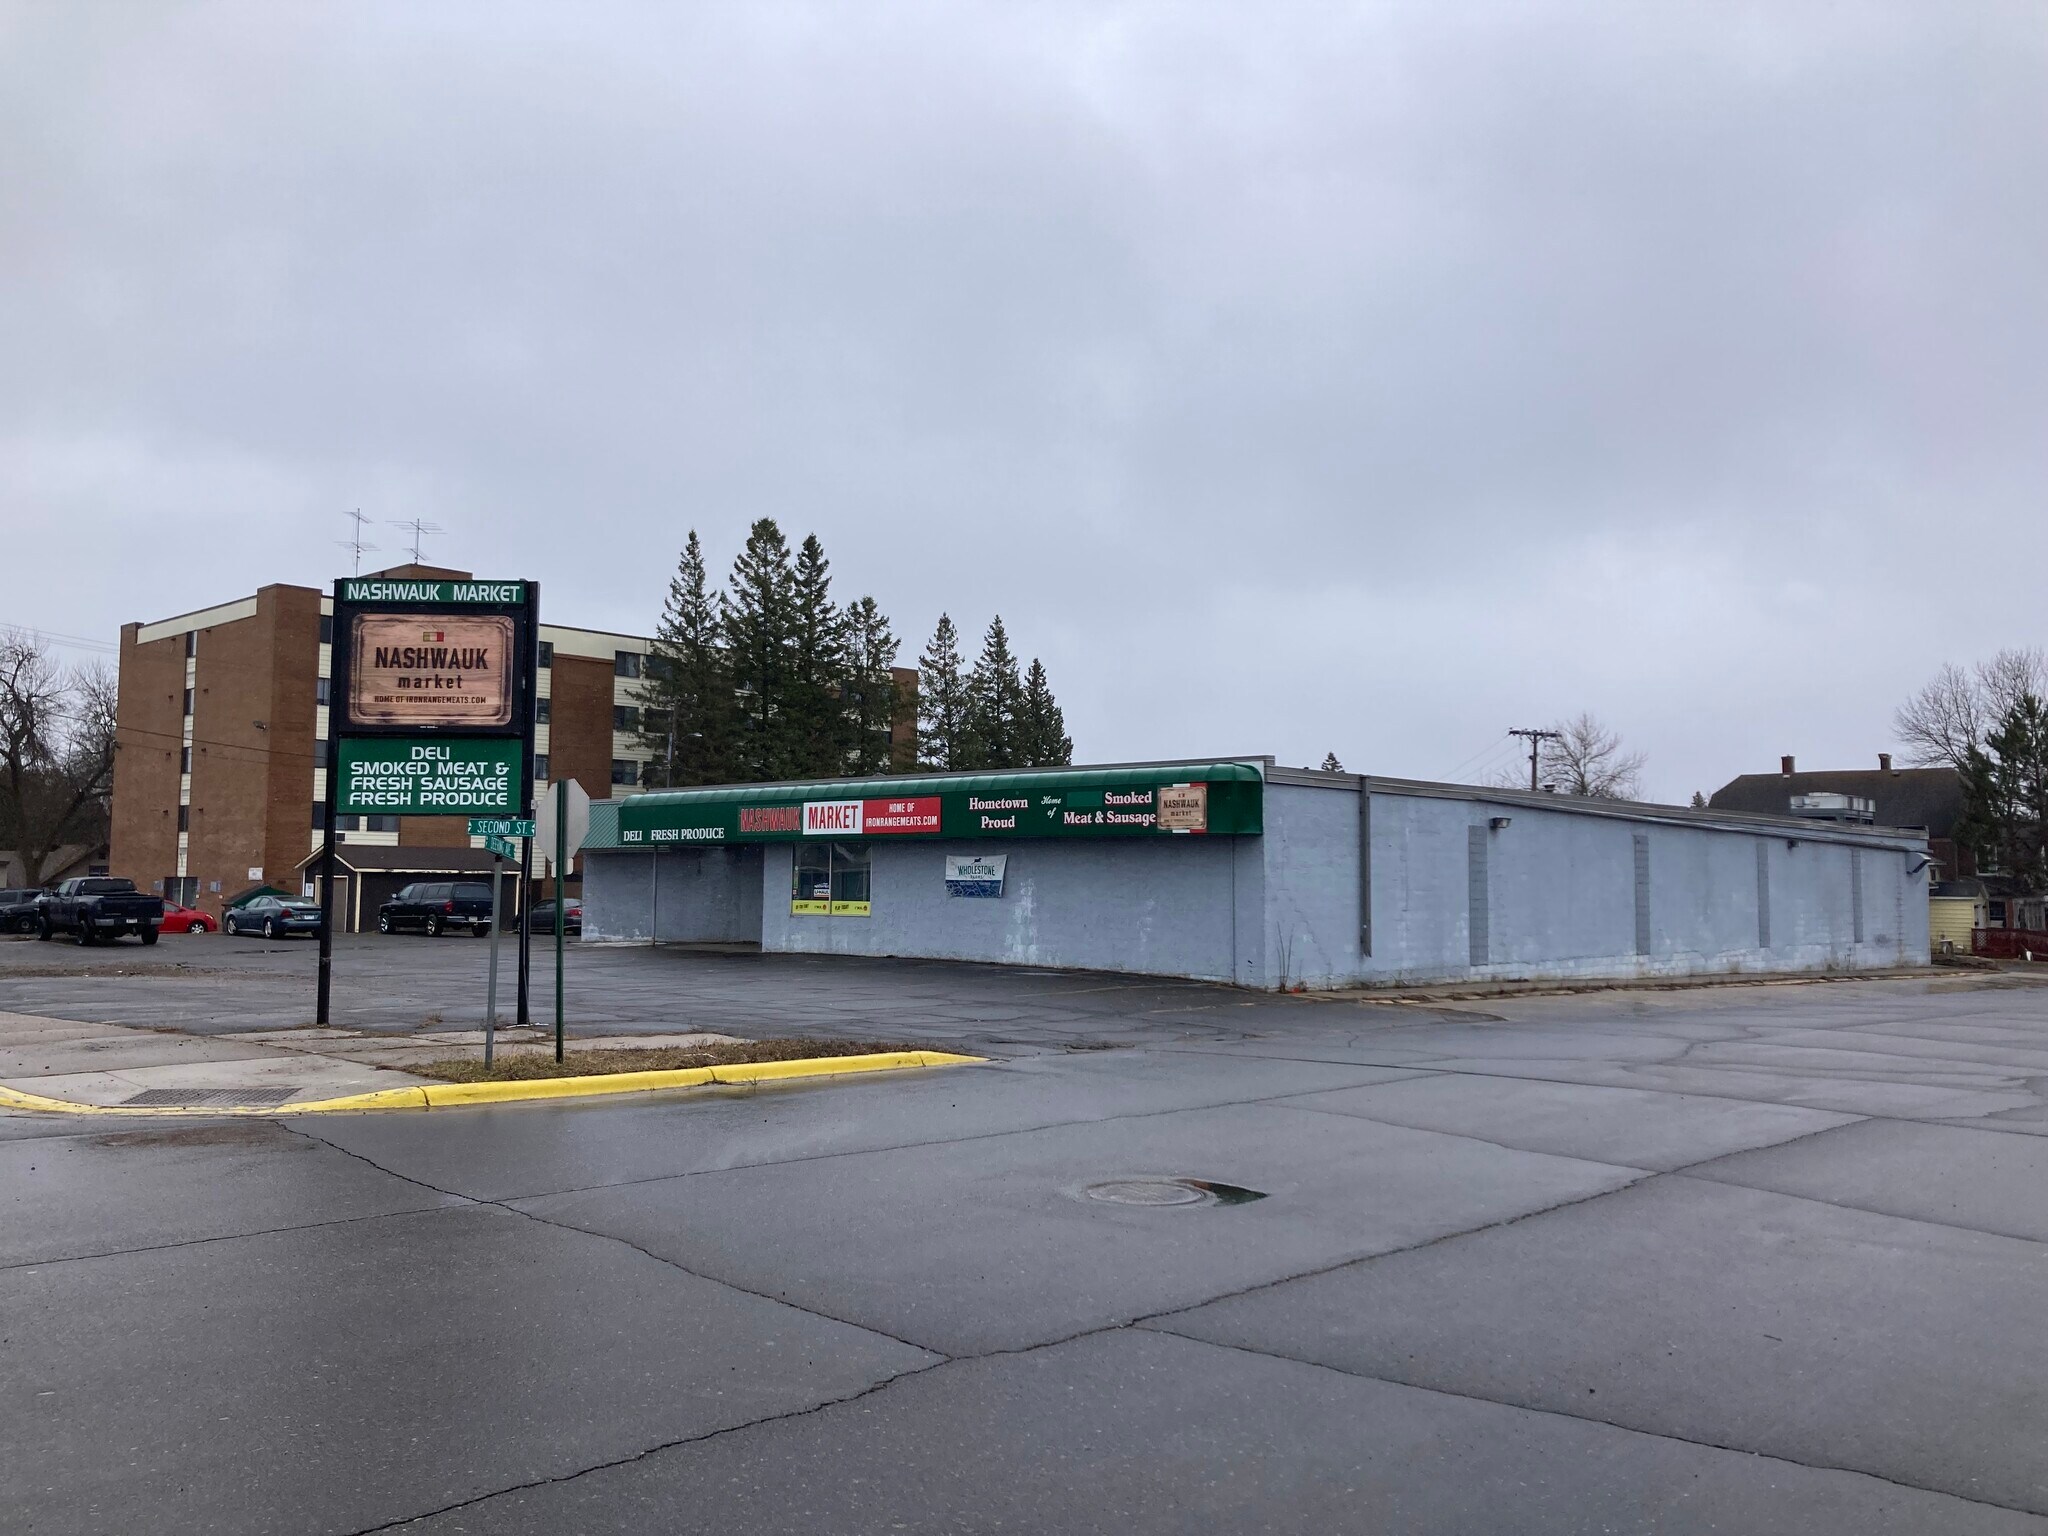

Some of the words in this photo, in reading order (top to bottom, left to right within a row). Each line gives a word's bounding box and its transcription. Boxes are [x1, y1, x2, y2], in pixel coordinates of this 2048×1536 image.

[348, 583, 440, 601] NASHWAUK
[453, 584, 520, 602] MARKET
[375, 647, 489, 669] NASHWAUK
[397, 674, 462, 689] market
[374, 695, 393, 703] HOME
[395, 695, 403, 703] OF
[406, 695, 487, 704] IRONRANGEMEATS.COM
[411, 746, 450, 760] DELI
[350, 762, 430, 775] SMOKED
[437, 762, 488, 775] MEAT
[495, 762, 509, 775] &
[351, 777, 412, 790] FRESH
[420, 777, 508, 790] SAUSAGE
[349, 792, 411, 806] FRESH
[419, 792, 508, 806] PRODUCE
[969, 797, 1029, 810] Hometown
[1041, 795, 1061, 805] Home
[1104, 791, 1152, 805] Smoked
[1163, 799, 1200, 809] NASHWAUK
[889, 803, 905, 813] HOME
[907, 802, 915, 812] OF
[1047, 807, 1057, 819] of
[741, 806, 801, 832] NASHWAUK
[808, 805, 858, 830] MARKET
[866, 815, 937, 828] IRONRANGEMEATS.COM
[981, 815, 1015, 829] Proud
[1063, 811, 1092, 824] Meat
[1094, 810, 1104, 824] &
[1106, 811, 1156, 827] Sausage
[477, 820, 511, 834] SECOND
[515, 821, 528, 835] ST.
[623, 830, 643, 841] DELI
[651, 828, 679, 841] FRESH
[681, 827, 725, 840] PRODUCE
[957, 865, 995, 876] WHOLESTONE
